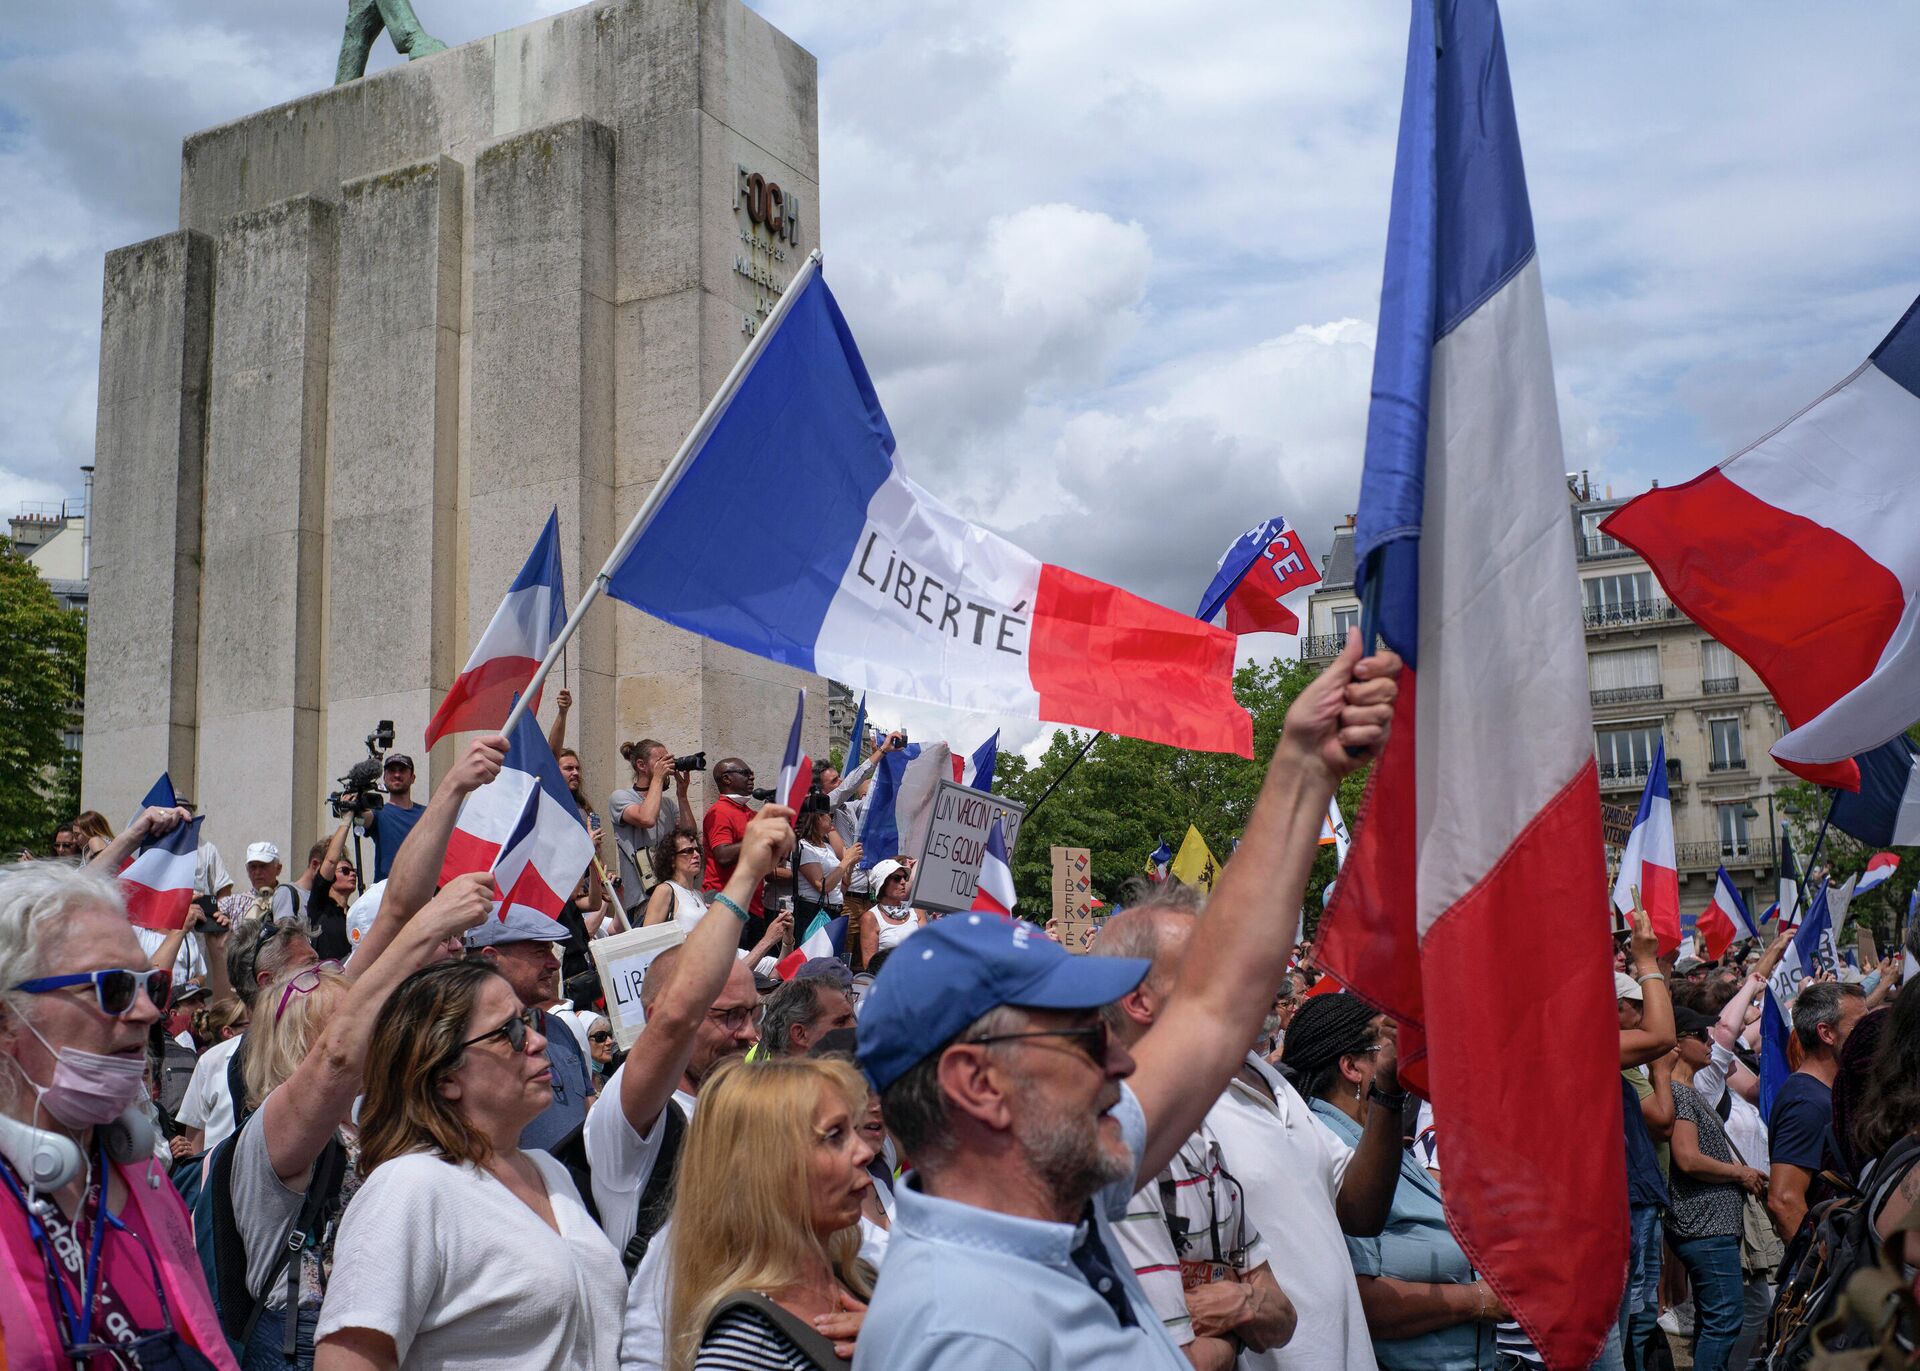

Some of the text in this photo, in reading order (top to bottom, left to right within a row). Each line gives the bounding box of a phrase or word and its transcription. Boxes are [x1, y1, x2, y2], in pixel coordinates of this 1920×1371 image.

[732, 163, 799, 246] FOCH
[936, 794, 956, 822] UN
[992, 807, 1018, 841] PUR
[928, 830, 951, 859] LES
[950, 869, 979, 899] TOUS
